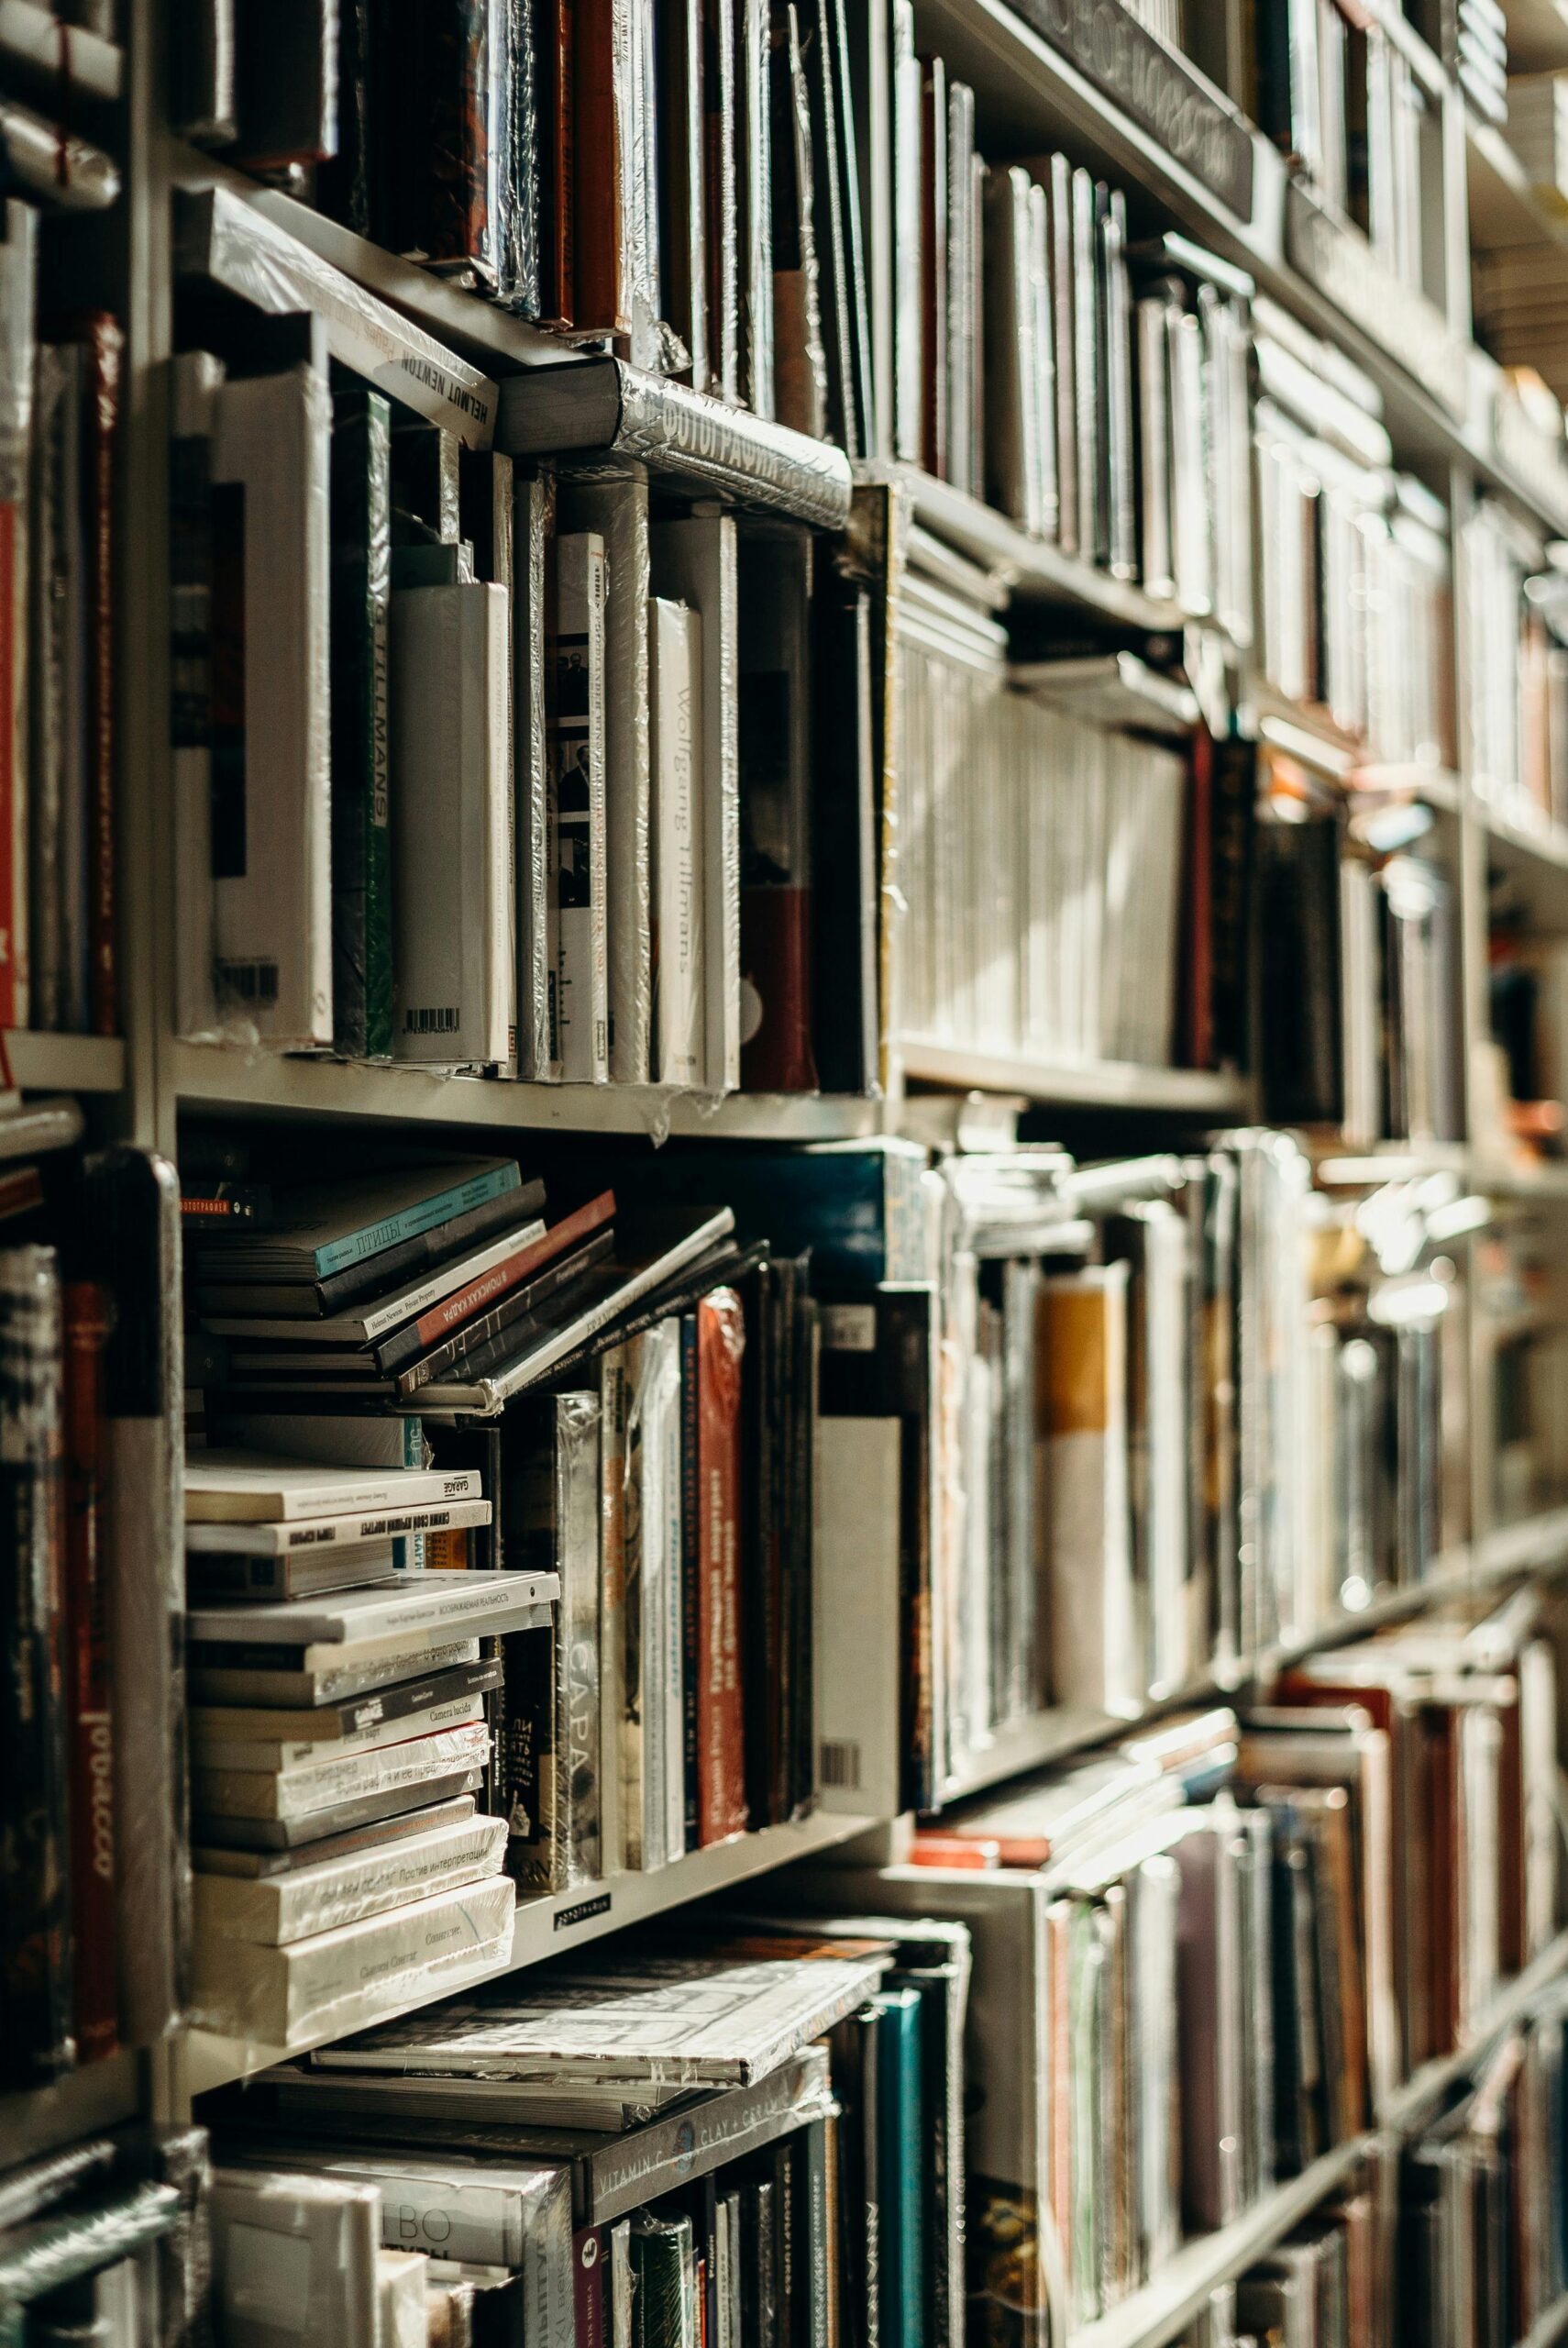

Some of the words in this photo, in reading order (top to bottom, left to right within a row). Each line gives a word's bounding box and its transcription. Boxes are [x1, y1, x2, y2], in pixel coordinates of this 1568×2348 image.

[402, 350, 446, 395] NEWTON
[447, 382, 488, 425] HELMUT
[374, 643, 387, 817] TILLMANS
[673, 687, 693, 831] Wolfgang
[679, 847, 693, 974] Tillmans
[356, 1220, 402, 1256] ПТИЦЫ
[468, 1274, 502, 1306] ПОИСКАХ
[386, 1308, 403, 1321] Newton
[443, 1299, 469, 1322] КАДРА
[444, 1480, 469, 1493] GARAGE
[360, 1522, 386, 1536] ПОРТРЕТ
[413, 1514, 428, 1531] СВОЙ
[439, 1600, 479, 1616] ВООБРАЖАЕМАЯ
[480, 1592, 509, 1607] РЕАЛЬНОСТЬ
[430, 1707, 453, 1722] Camera
[453, 1702, 472, 1716] lucida
[399, 1865, 428, 1881] Против
[430, 1848, 490, 1872] интерпретации
[599, 2156, 651, 2194] VITAMIN
[700, 2119, 729, 2147] CLAY
